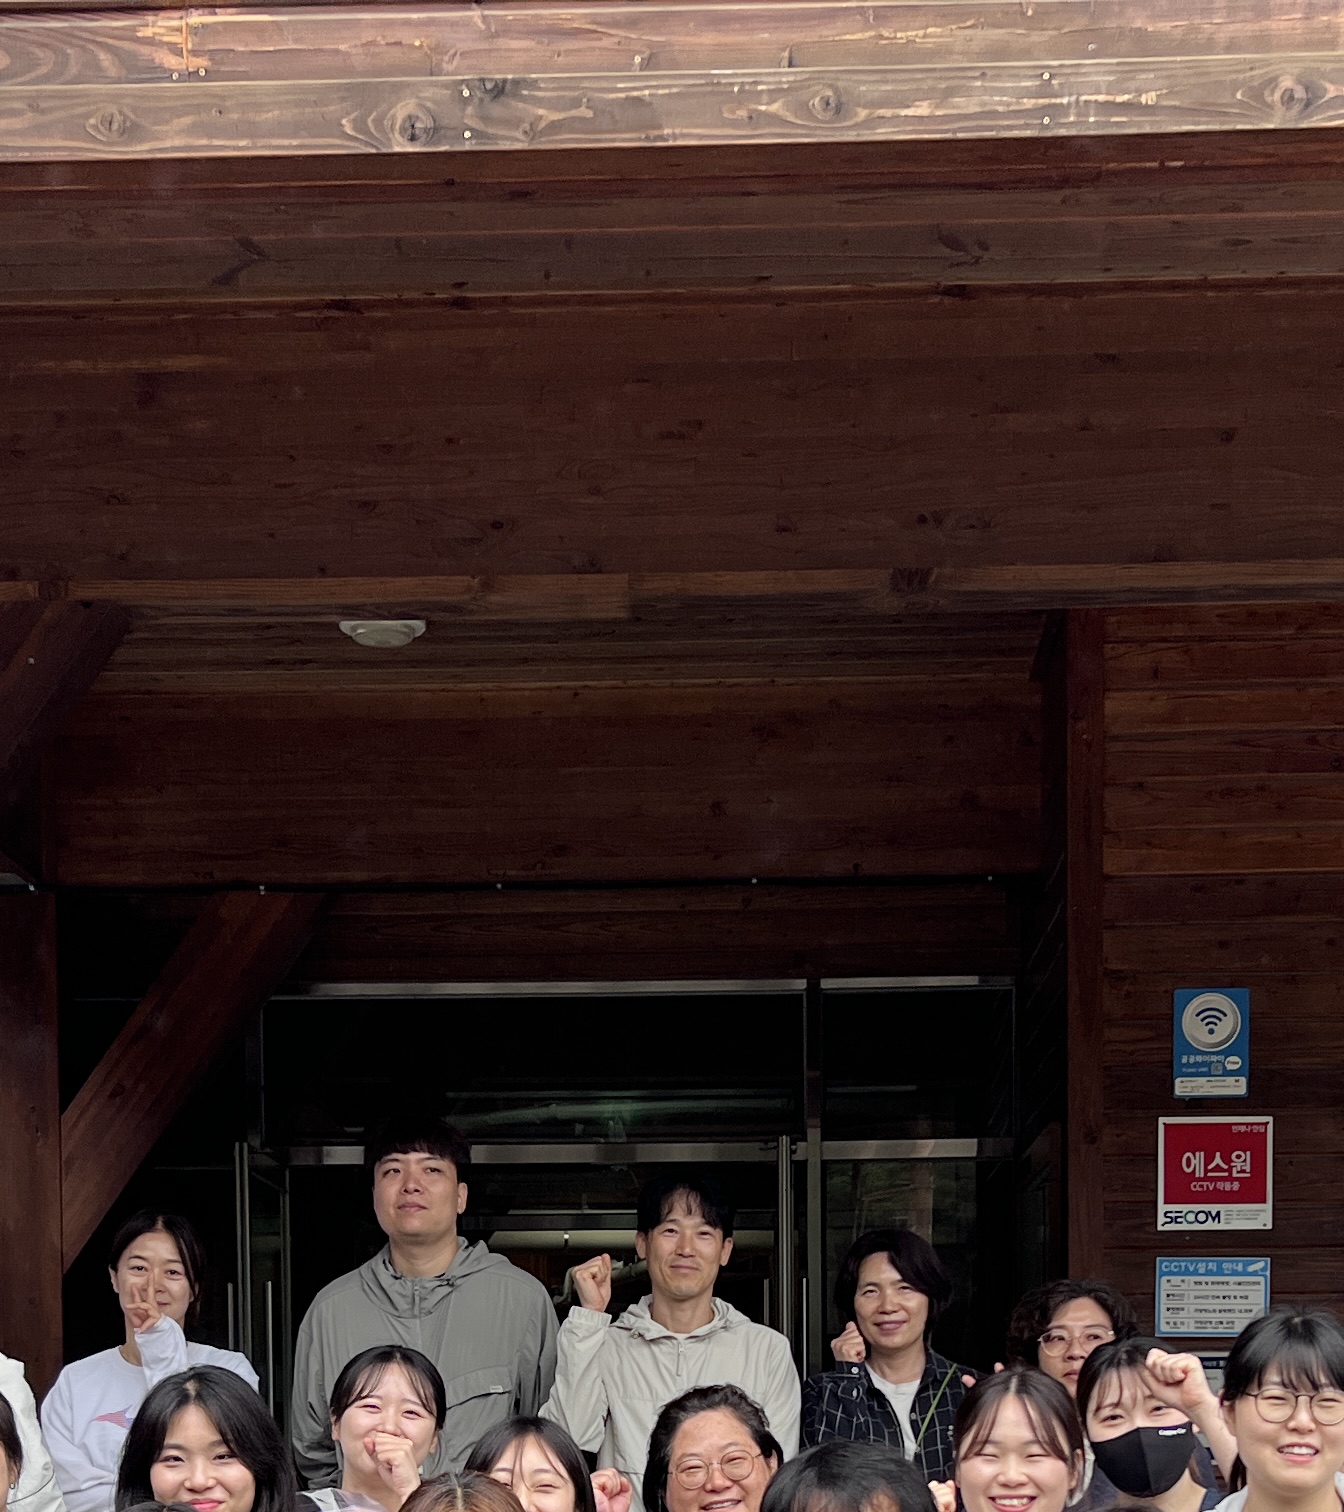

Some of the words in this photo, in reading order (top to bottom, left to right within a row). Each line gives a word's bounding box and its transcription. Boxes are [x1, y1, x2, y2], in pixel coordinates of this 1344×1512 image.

[1181, 1150, 1251, 1178] 에스원
[1190, 1181, 1215, 1191] CCTV
[1161, 1210, 1221, 1226] SECOM
[1222, 1262, 1244, 1274] 안내
